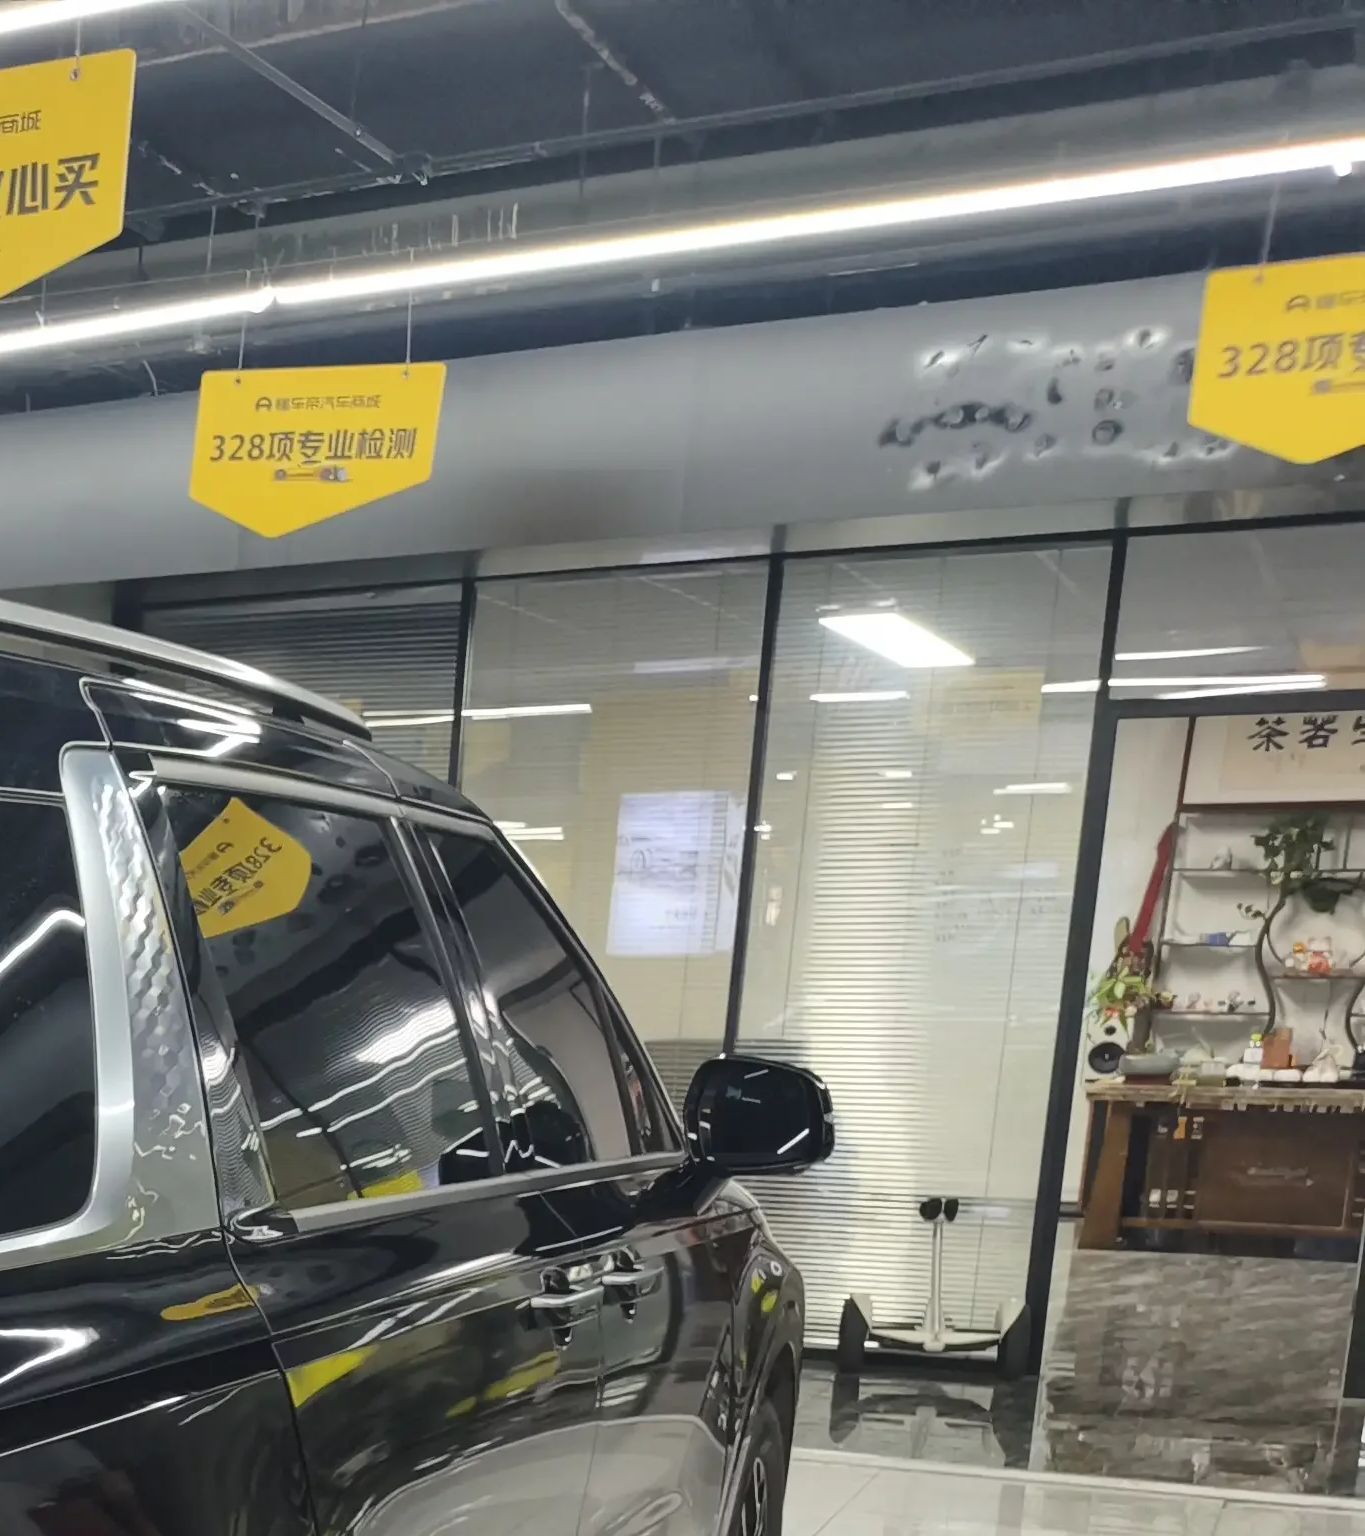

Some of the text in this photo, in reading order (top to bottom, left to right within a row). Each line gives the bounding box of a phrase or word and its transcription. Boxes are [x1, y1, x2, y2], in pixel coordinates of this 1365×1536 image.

[209, 427, 418, 464] 328项专业检测
